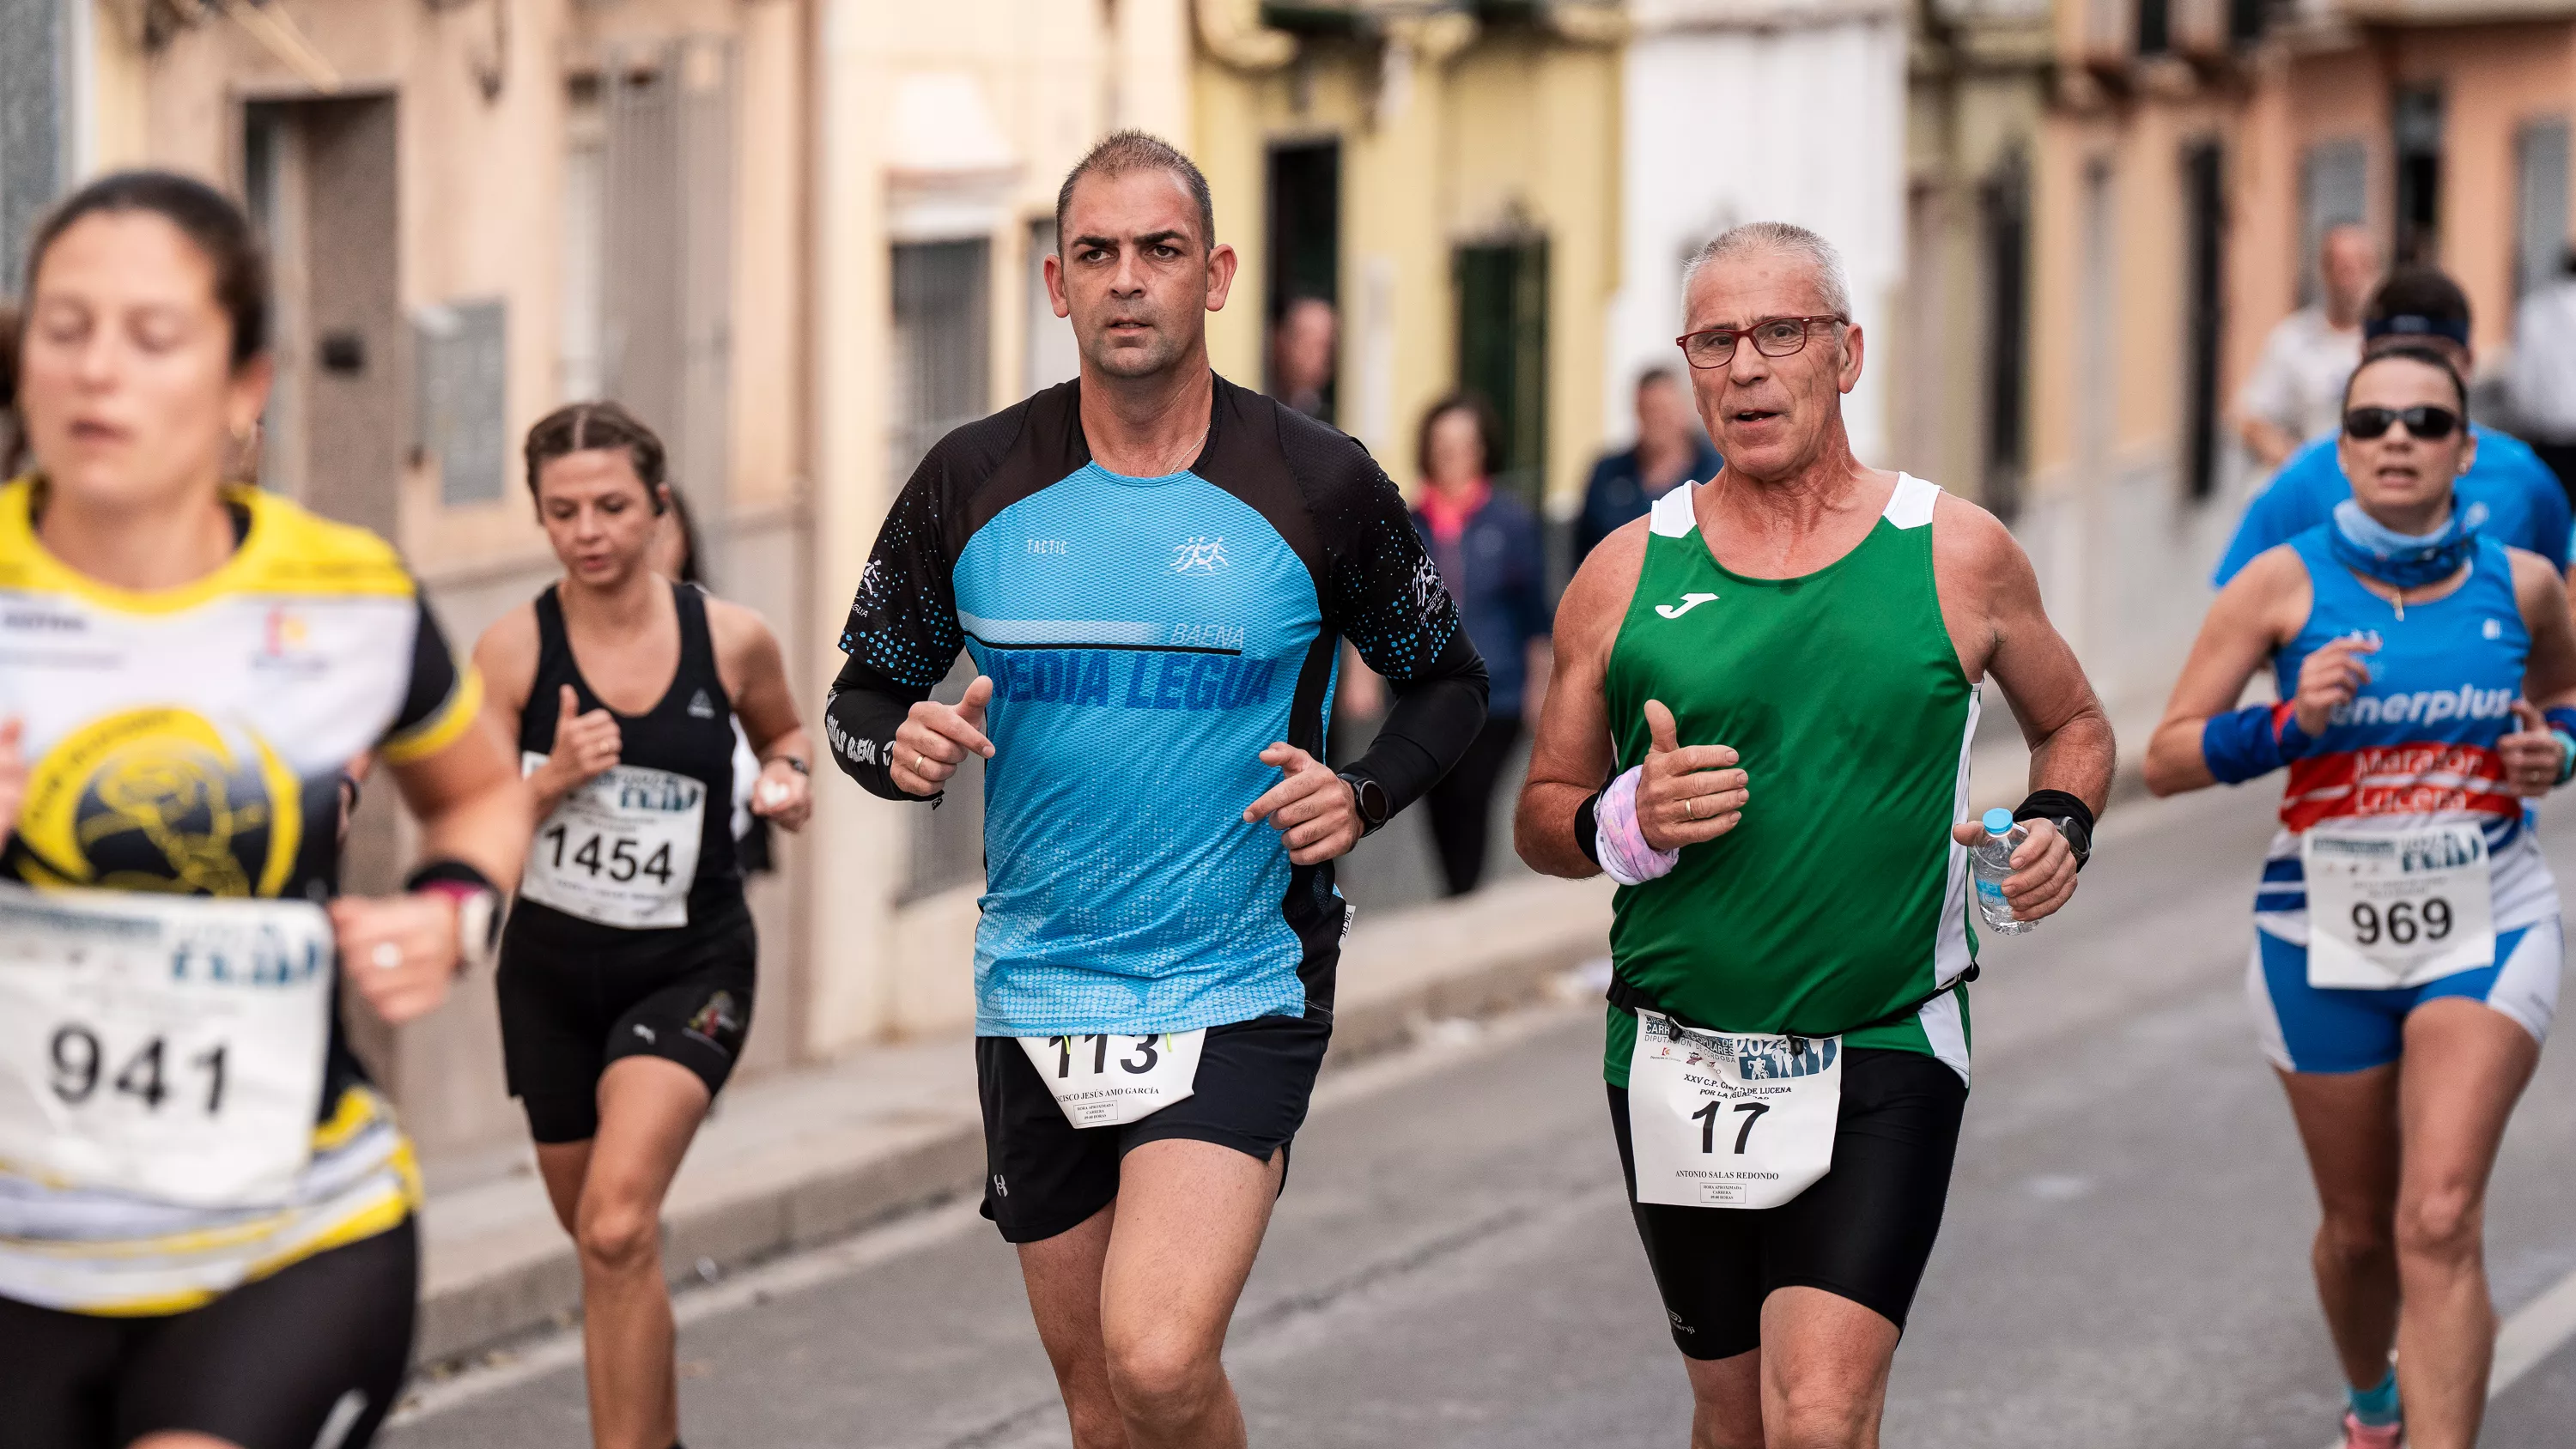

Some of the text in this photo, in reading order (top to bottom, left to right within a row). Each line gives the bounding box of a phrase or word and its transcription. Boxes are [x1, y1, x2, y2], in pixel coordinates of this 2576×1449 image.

[1027, 539, 1067, 555] TACTIC
[1170, 622, 1244, 649] BAENA
[1124, 652, 1278, 712] LEGUA
[545, 823, 673, 885] 1454
[1341, 911, 1353, 938] TACTIC
[2352, 898, 2453, 945] 969
[50, 1022, 230, 1113] 941
[1048, 1033, 1159, 1079] 113
[1080, 1089, 1103, 1100] JESÚS
[1104, 1088, 1124, 1097] AMO
[1125, 1087, 1159, 1095] GARCÍA
[1684, 1074, 1704, 1084] XXV
[1704, 1078, 1718, 1088] C.P.
[1691, 1100, 1771, 1155] 17
[1675, 1170, 1779, 1180] ANTONIO SALAS REDONDO
